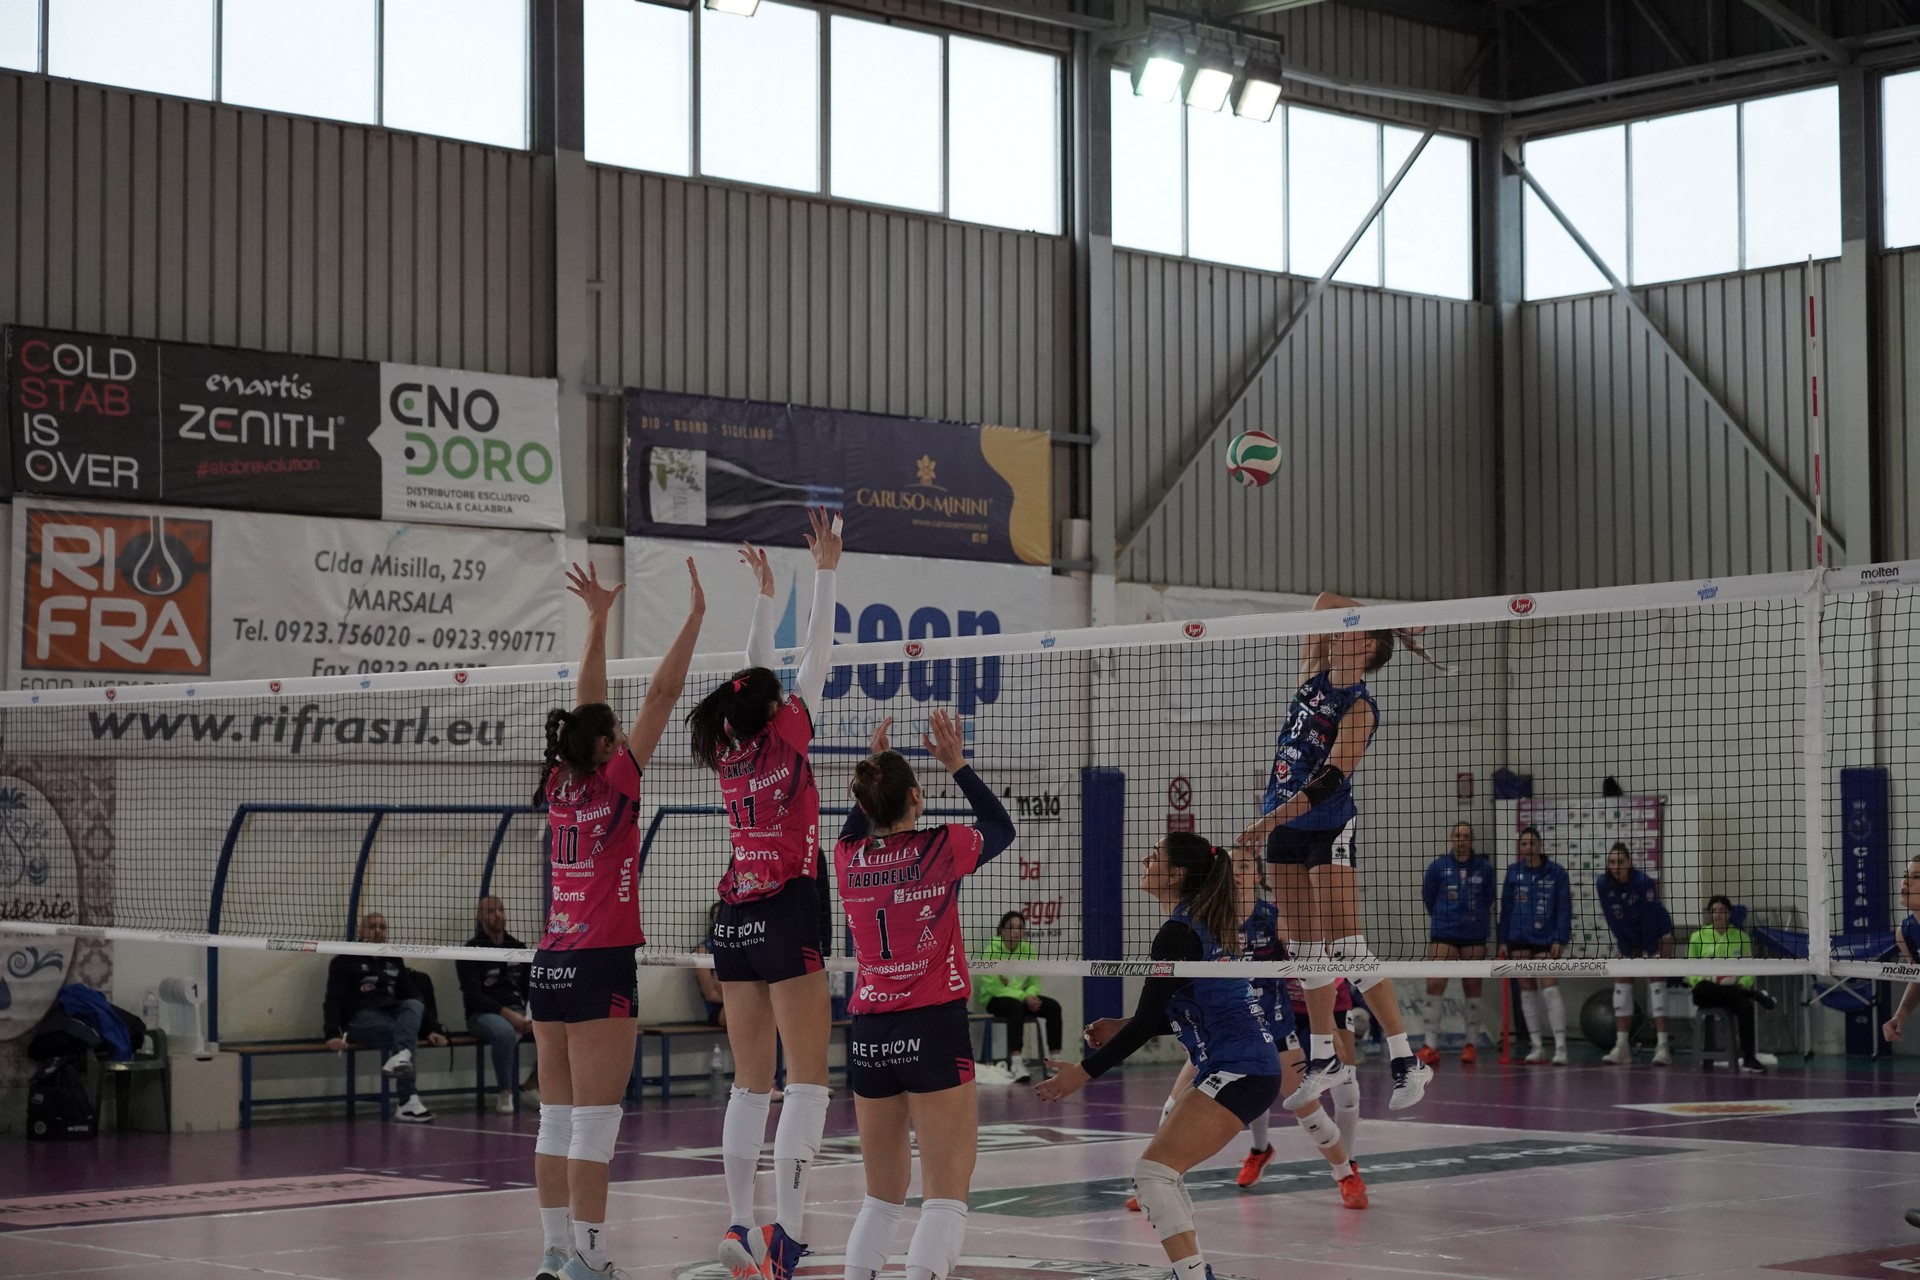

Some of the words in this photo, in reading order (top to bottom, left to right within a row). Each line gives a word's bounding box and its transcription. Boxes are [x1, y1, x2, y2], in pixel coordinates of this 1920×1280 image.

[20, 339, 137, 381] COLD
[19, 376, 131, 416] STAB
[205, 373, 313, 399] enartis
[23, 412, 60, 446] IS
[25, 449, 139, 489] OVER
[404, 432, 553, 485] DORO
[406, 486, 475, 500] DISTRIBUTORE
[477, 491, 530, 503] ESCLUSIVO
[406, 500, 417, 508] IN
[419, 501, 453, 511] SICILIA
[456, 503, 462, 511] E
[464, 503, 514, 514] CALABRIA
[315, 550, 364, 574] C/da
[370, 554, 446, 583] Misilla,
[452, 559, 487, 582] 259
[1861, 567, 1899, 579] molten
[348, 588, 453, 615] MARSALA
[36, 594, 202, 668] FRA
[233, 618, 268, 642] Tel.
[275, 620, 411, 647] 0923.756020
[432, 627, 556, 653] 0923.990777
[88, 703, 506, 754] www.rifrasrl.eu
[757, 767, 790, 791] zanin
[582, 806, 611, 822] zanin
[731, 795, 755, 829] 17
[557, 825, 579, 866] 10
[848, 844, 921, 868] ACHILLEA
[847, 863, 921, 888] TABORELLI
[905, 885, 946, 902] zanin
[875, 908, 893, 960] 1
[1297, 963, 1327, 972] MASTER
[1515, 962, 1547, 971] MASTER
[1881, 966, 1920, 976] molten
